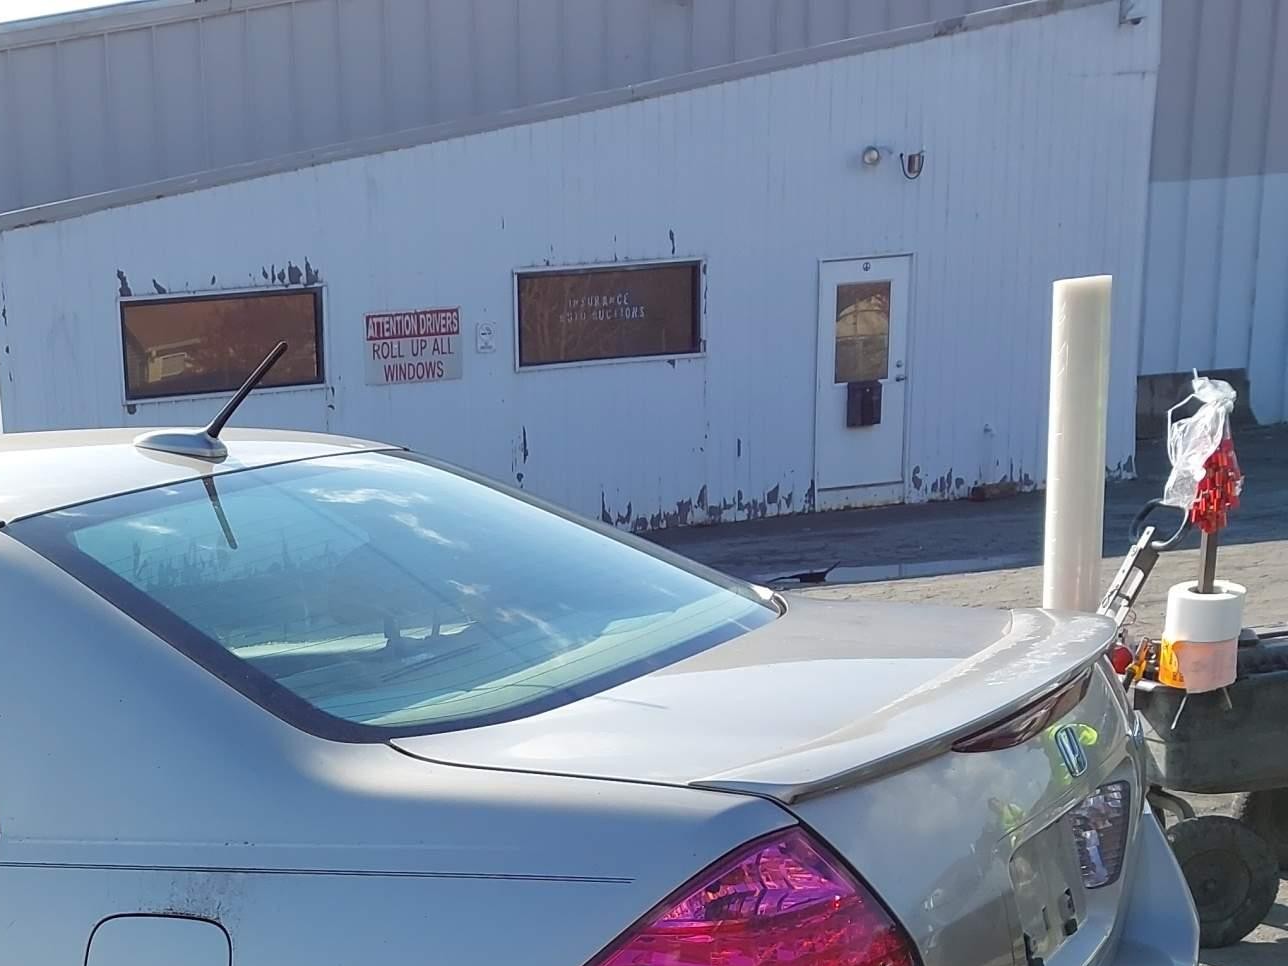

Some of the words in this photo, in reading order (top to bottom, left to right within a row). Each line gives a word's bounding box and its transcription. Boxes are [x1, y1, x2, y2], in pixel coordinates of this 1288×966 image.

[367, 314, 418, 339] ATTENTION
[419, 311, 458, 336] DRIVERS
[372, 341, 404, 360] ROLL
[411, 339, 428, 357] UP
[431, 337, 455, 355] ALL
[383, 360, 444, 383] WINDOWS
